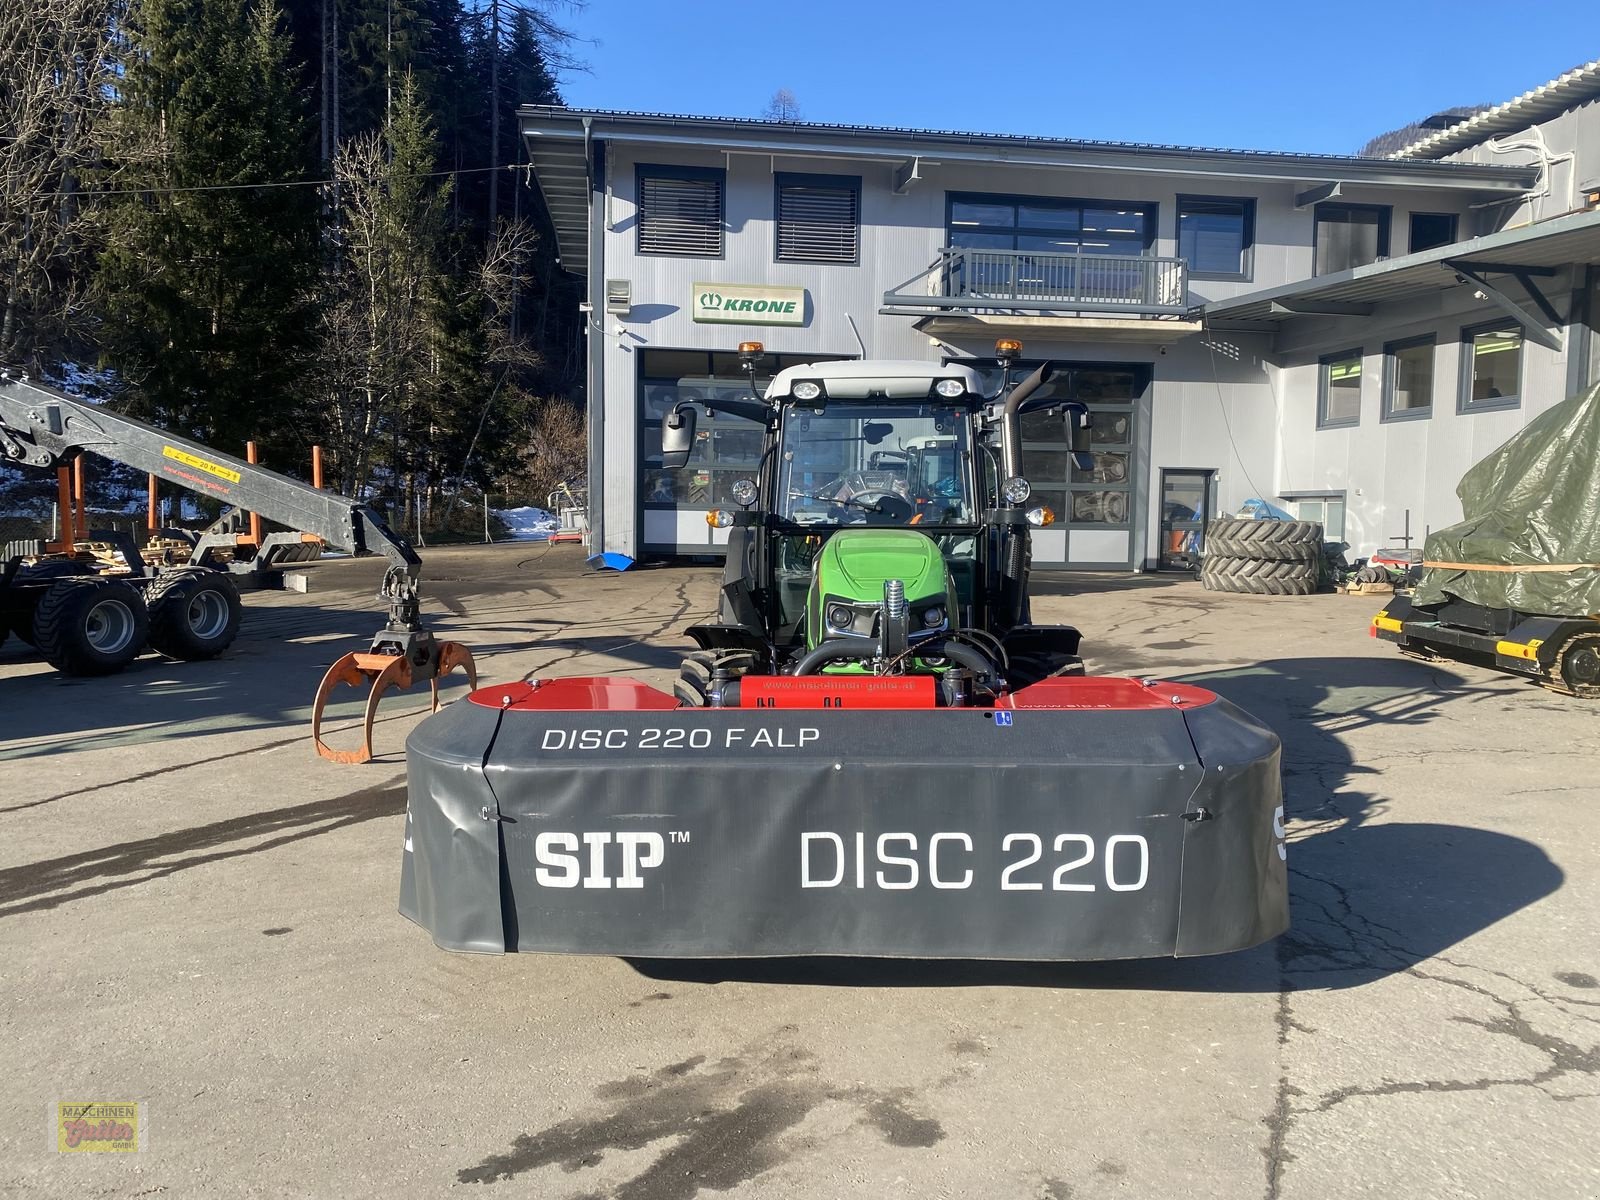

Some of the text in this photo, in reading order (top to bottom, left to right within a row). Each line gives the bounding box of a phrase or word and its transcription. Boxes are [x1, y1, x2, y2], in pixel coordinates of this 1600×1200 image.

[724, 299, 796, 313] KRONE
[200, 461, 217, 473] 20 M
[541, 729, 629, 749] DISC
[638, 728, 712, 748] 220
[535, 831, 665, 889] SIP
[801, 831, 1149, 892] DISC 220
